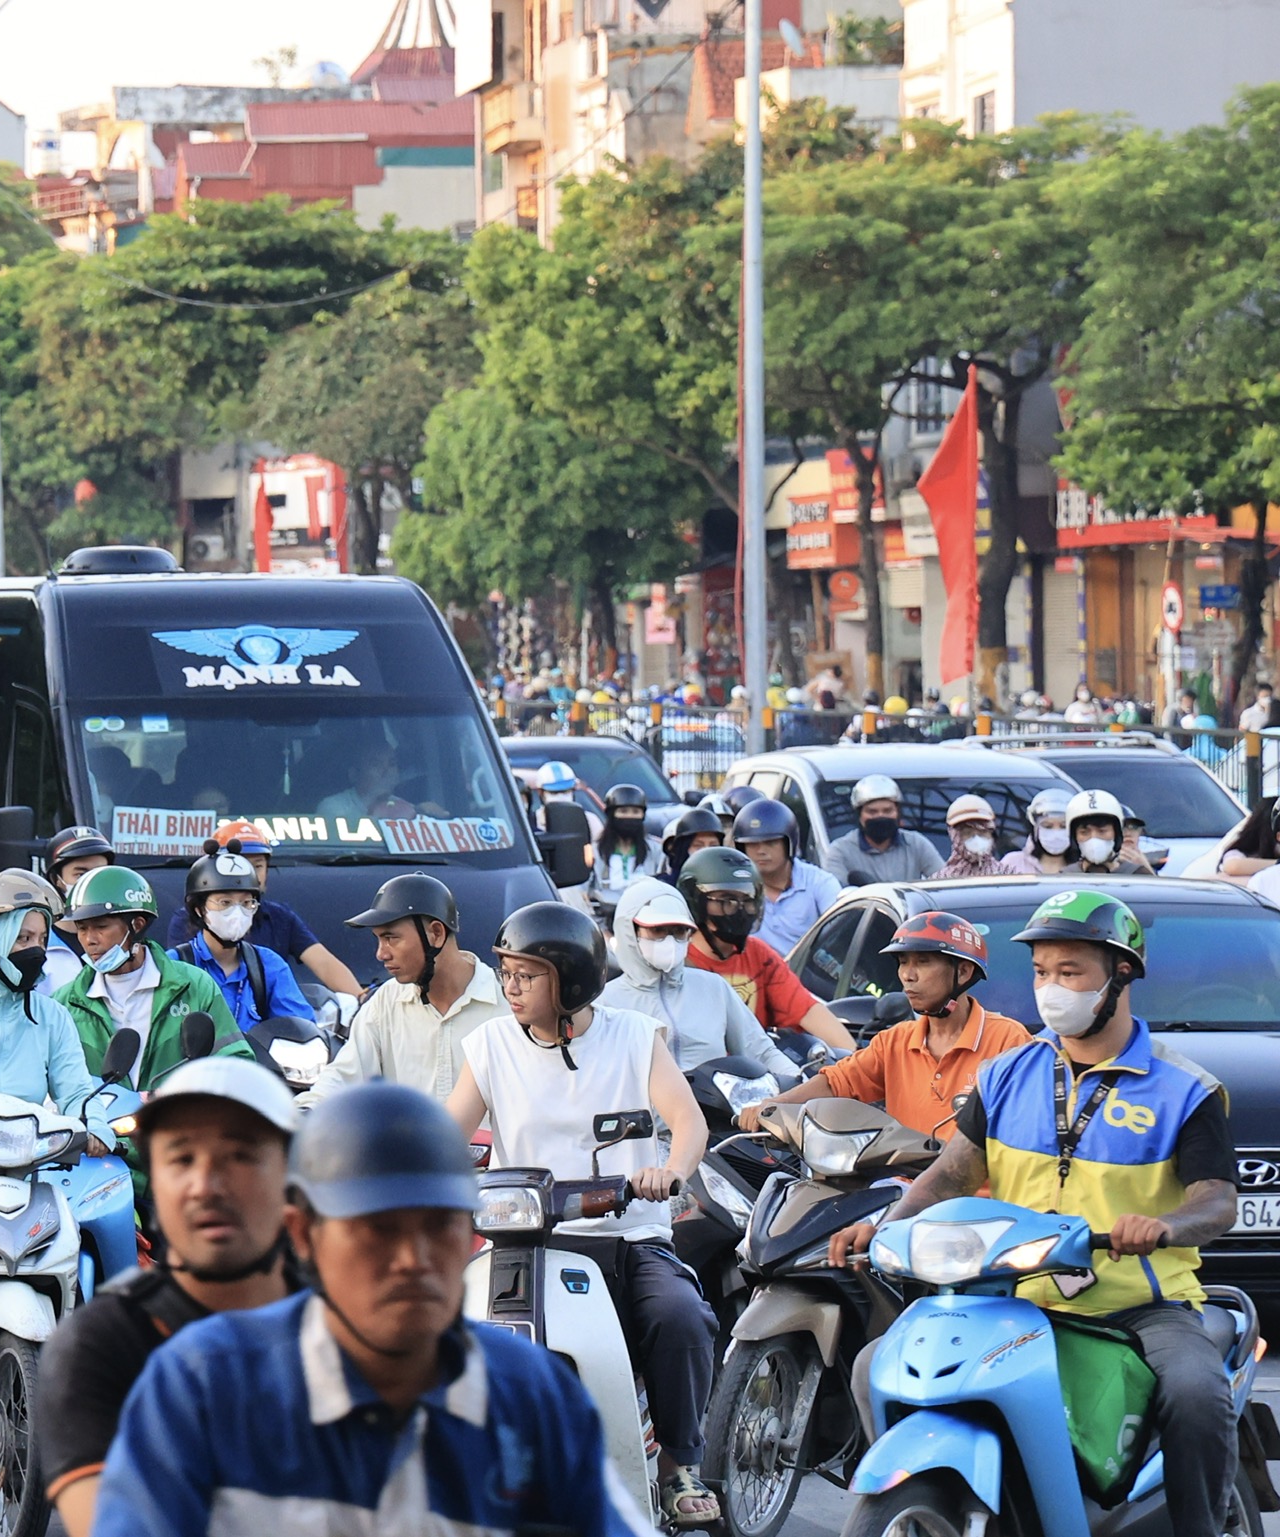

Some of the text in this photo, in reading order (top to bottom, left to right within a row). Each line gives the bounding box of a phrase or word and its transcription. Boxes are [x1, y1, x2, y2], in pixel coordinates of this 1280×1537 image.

[182, 664, 361, 690] MẠNH LA
[116, 808, 213, 838] THÁI BÌNH
[217, 816, 382, 847] ẠNH LA
[384, 814, 449, 852] THÁI
[124, 887, 153, 903] Grab
[170, 1000, 190, 1017] ab
[1103, 1087, 1156, 1134] be
[927, 1311, 969, 1319] HONDA
